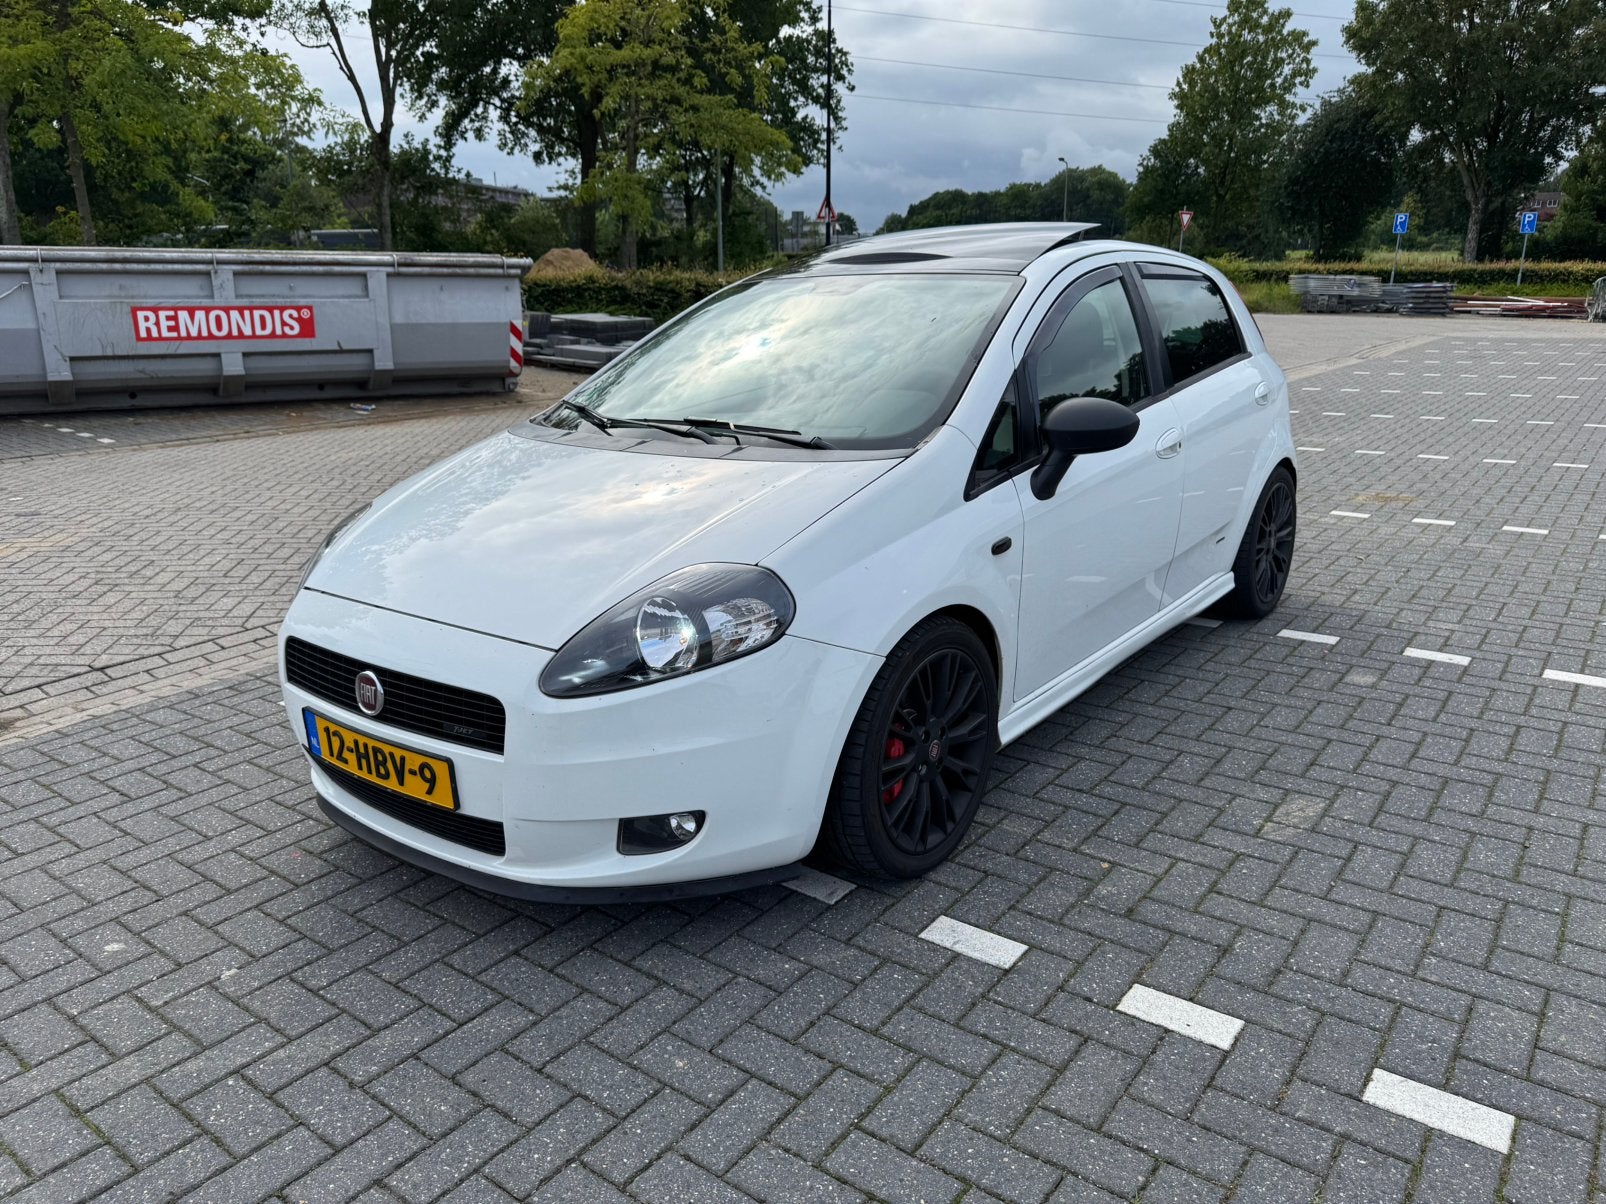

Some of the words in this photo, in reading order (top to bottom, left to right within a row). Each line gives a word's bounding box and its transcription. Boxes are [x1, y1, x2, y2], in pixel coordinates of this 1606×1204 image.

[1397, 215, 1406, 225] P
[1525, 214, 1534, 225] P
[136, 309, 301, 338] REMONDIS
[360, 682, 376, 705] FIAT
[323, 725, 437, 796] 12-HBV-9
